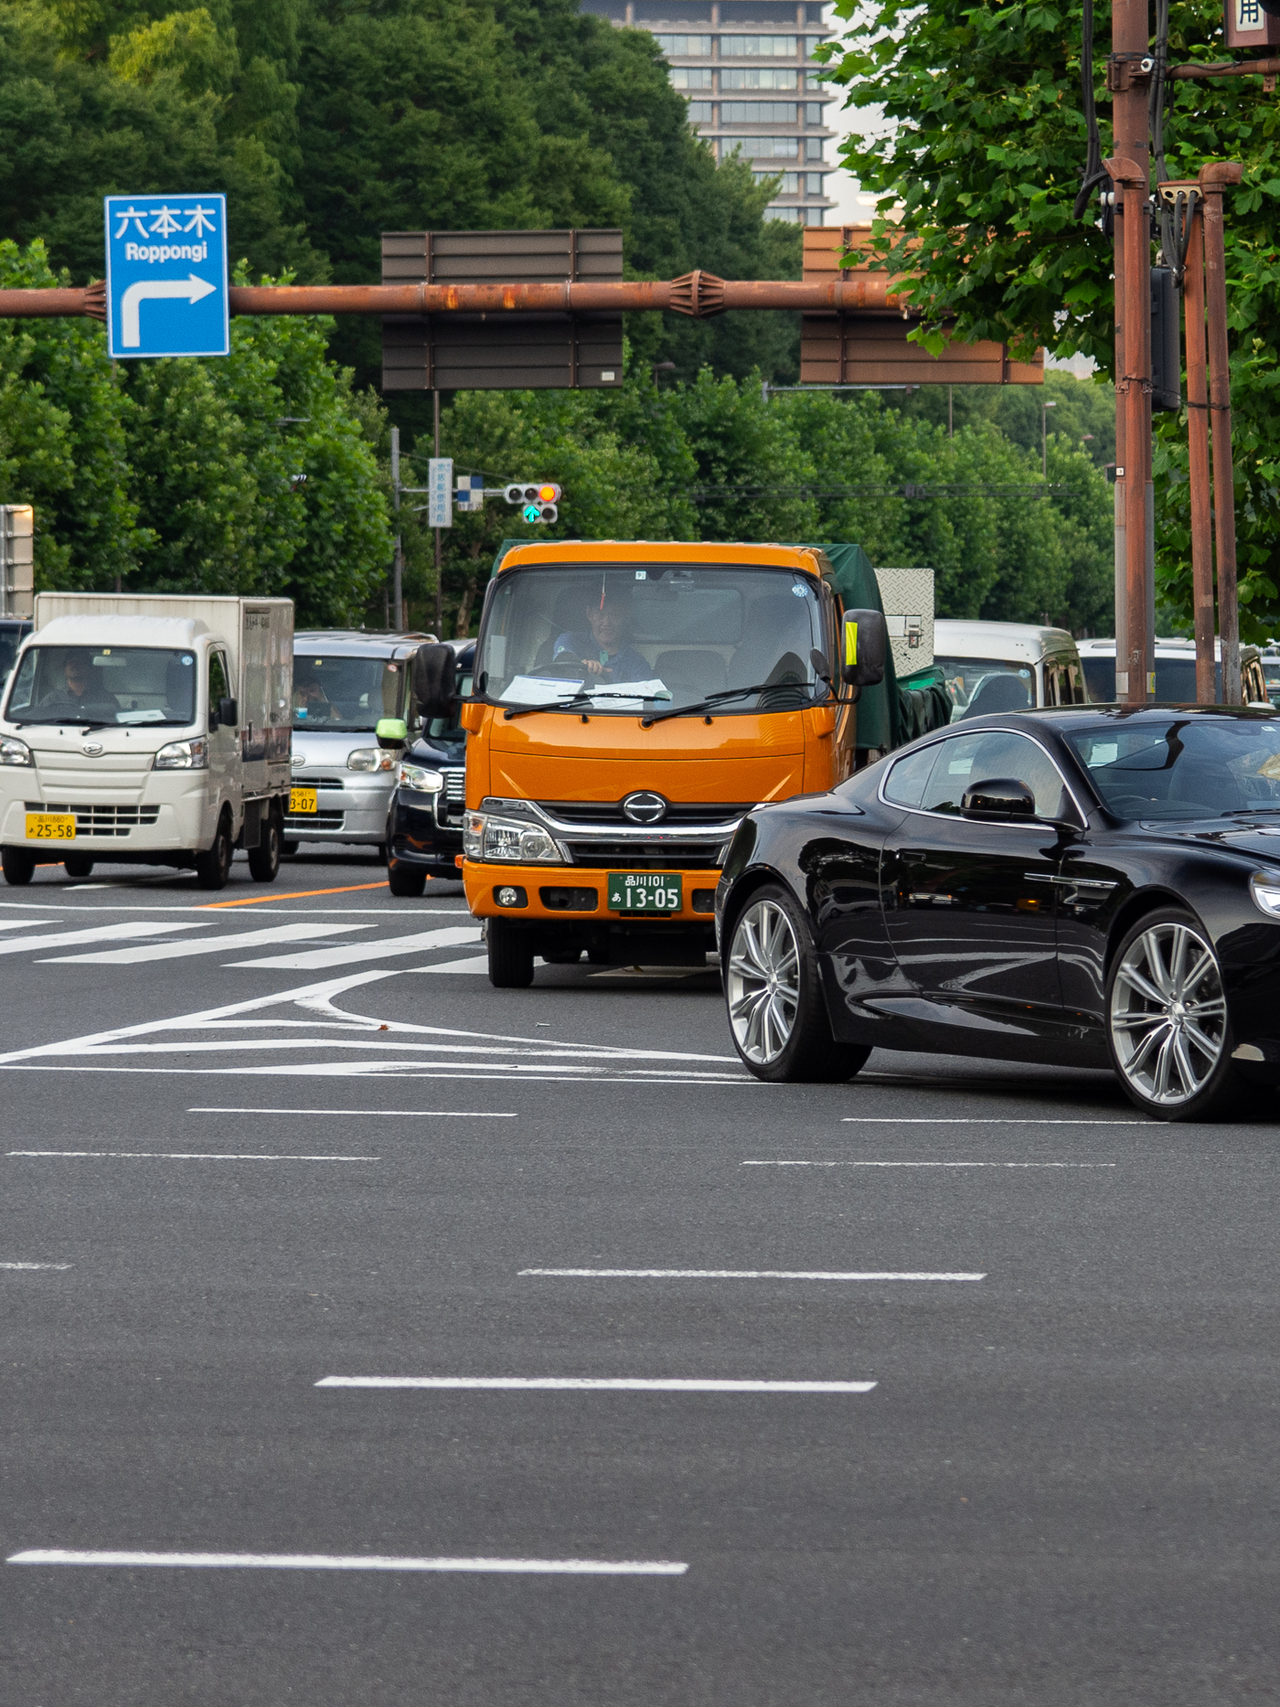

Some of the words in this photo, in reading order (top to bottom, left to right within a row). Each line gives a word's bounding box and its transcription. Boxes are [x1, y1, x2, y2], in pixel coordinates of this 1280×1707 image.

[115, 204, 217, 239] 六本木
[125, 241, 207, 263] Roppongi
[291, 798, 315, 810] 3-07
[37, 824, 73, 837] 25-58
[611, 892, 621, 902] あ
[626, 888, 678, 908] 13-05
